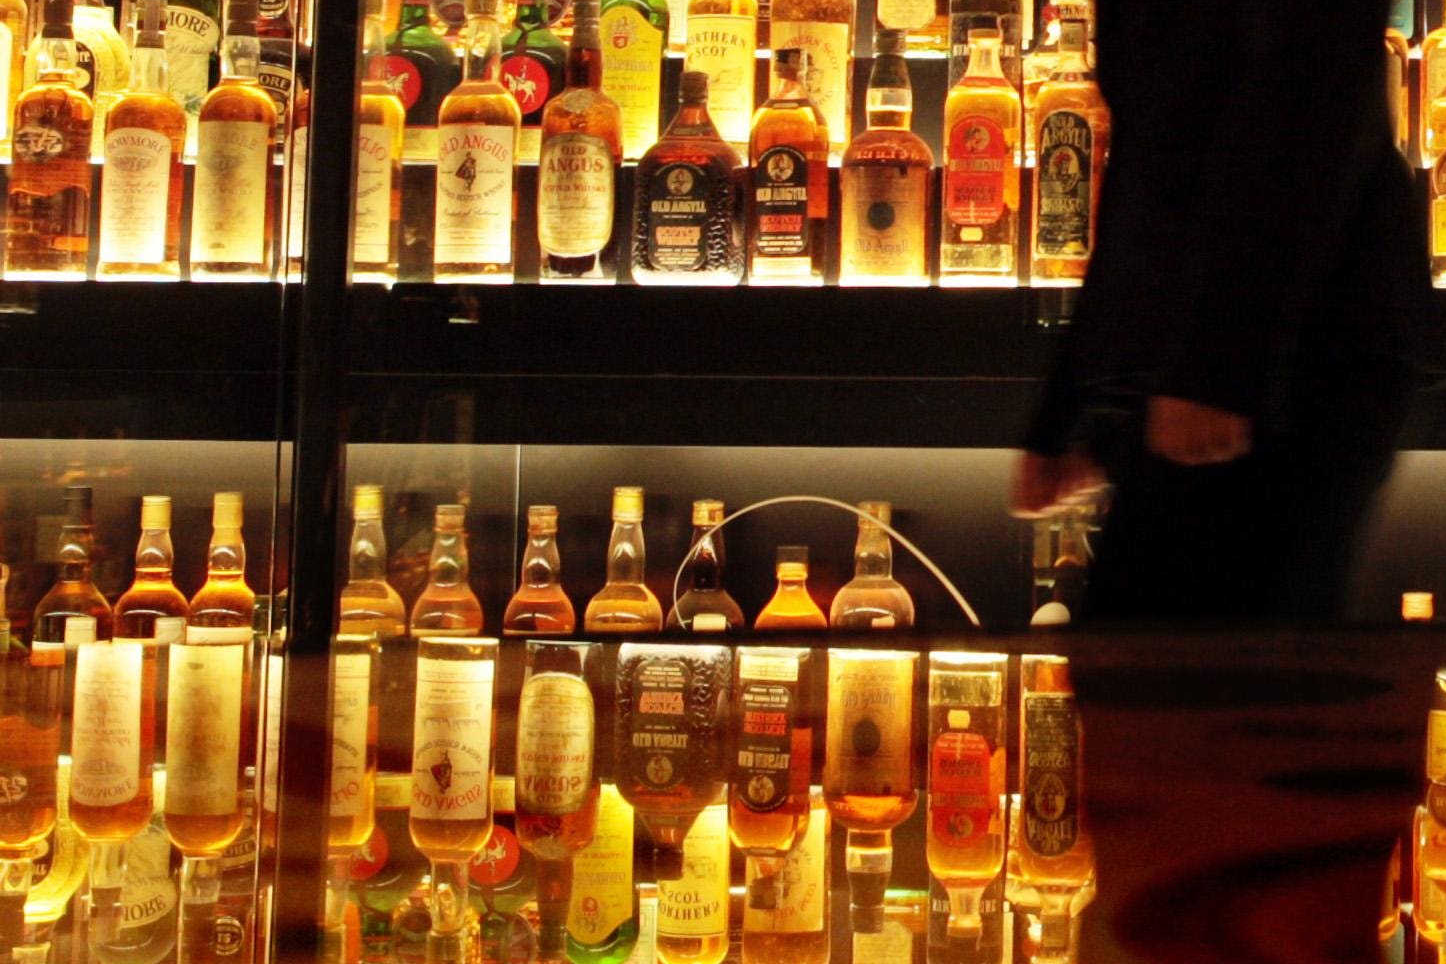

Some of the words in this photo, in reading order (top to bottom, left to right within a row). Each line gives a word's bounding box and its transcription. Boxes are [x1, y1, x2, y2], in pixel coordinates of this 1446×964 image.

[696, 46, 728, 59] SCOT
[459, 133, 509, 162] ANGUS
[561, 146, 587, 156] OLD
[548, 157, 604, 174] ANGUS
